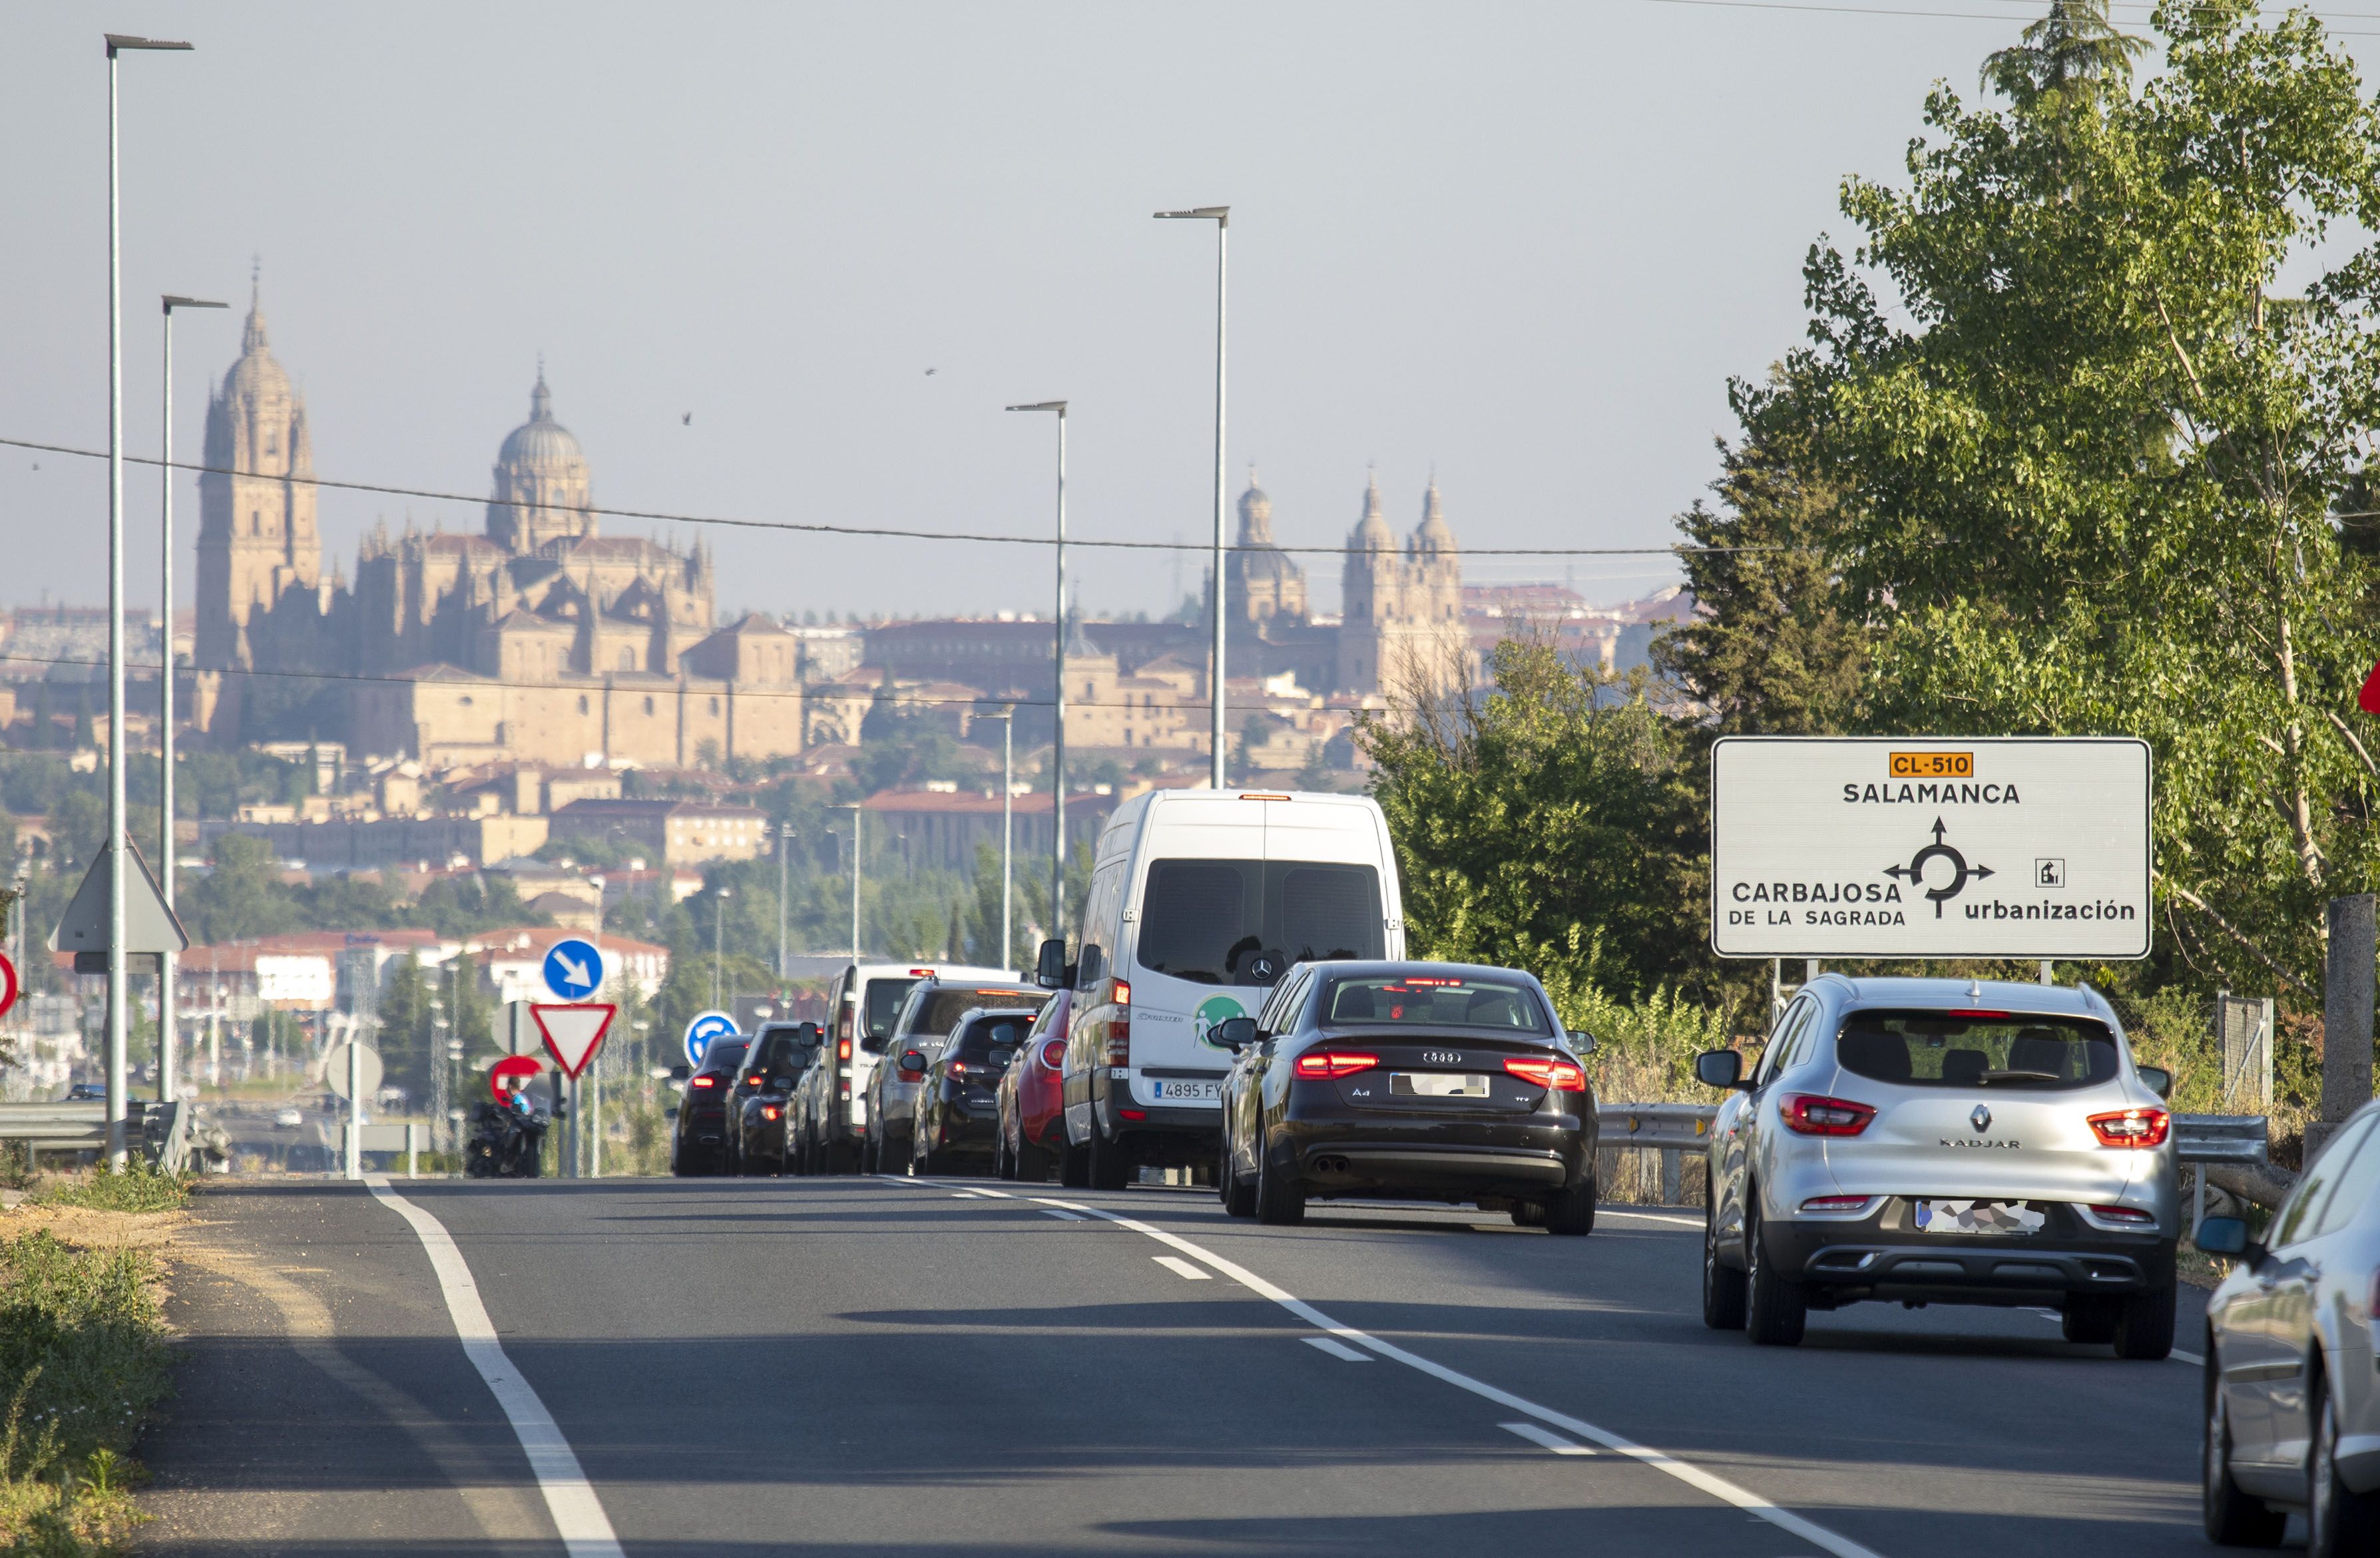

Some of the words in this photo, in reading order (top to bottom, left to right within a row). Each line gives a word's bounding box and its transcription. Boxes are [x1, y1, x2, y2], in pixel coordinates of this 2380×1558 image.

[1893, 757, 1969, 774] CL-510
[1843, 783, 2021, 805] SALAMANCA
[1732, 882, 1903, 904] CARBAJOSA
[1965, 899, 2135, 920] urbanización
[1730, 910, 1756, 926] DE
[1768, 910, 1792, 926] LA
[1805, 910, 1906, 926] SAGRADA
[1165, 1083, 1200, 1097] 4895
[1205, 1084, 1222, 1098] FY
[1352, 1087, 1371, 1097] A4
[1939, 1138, 2023, 1149] KADJAR
